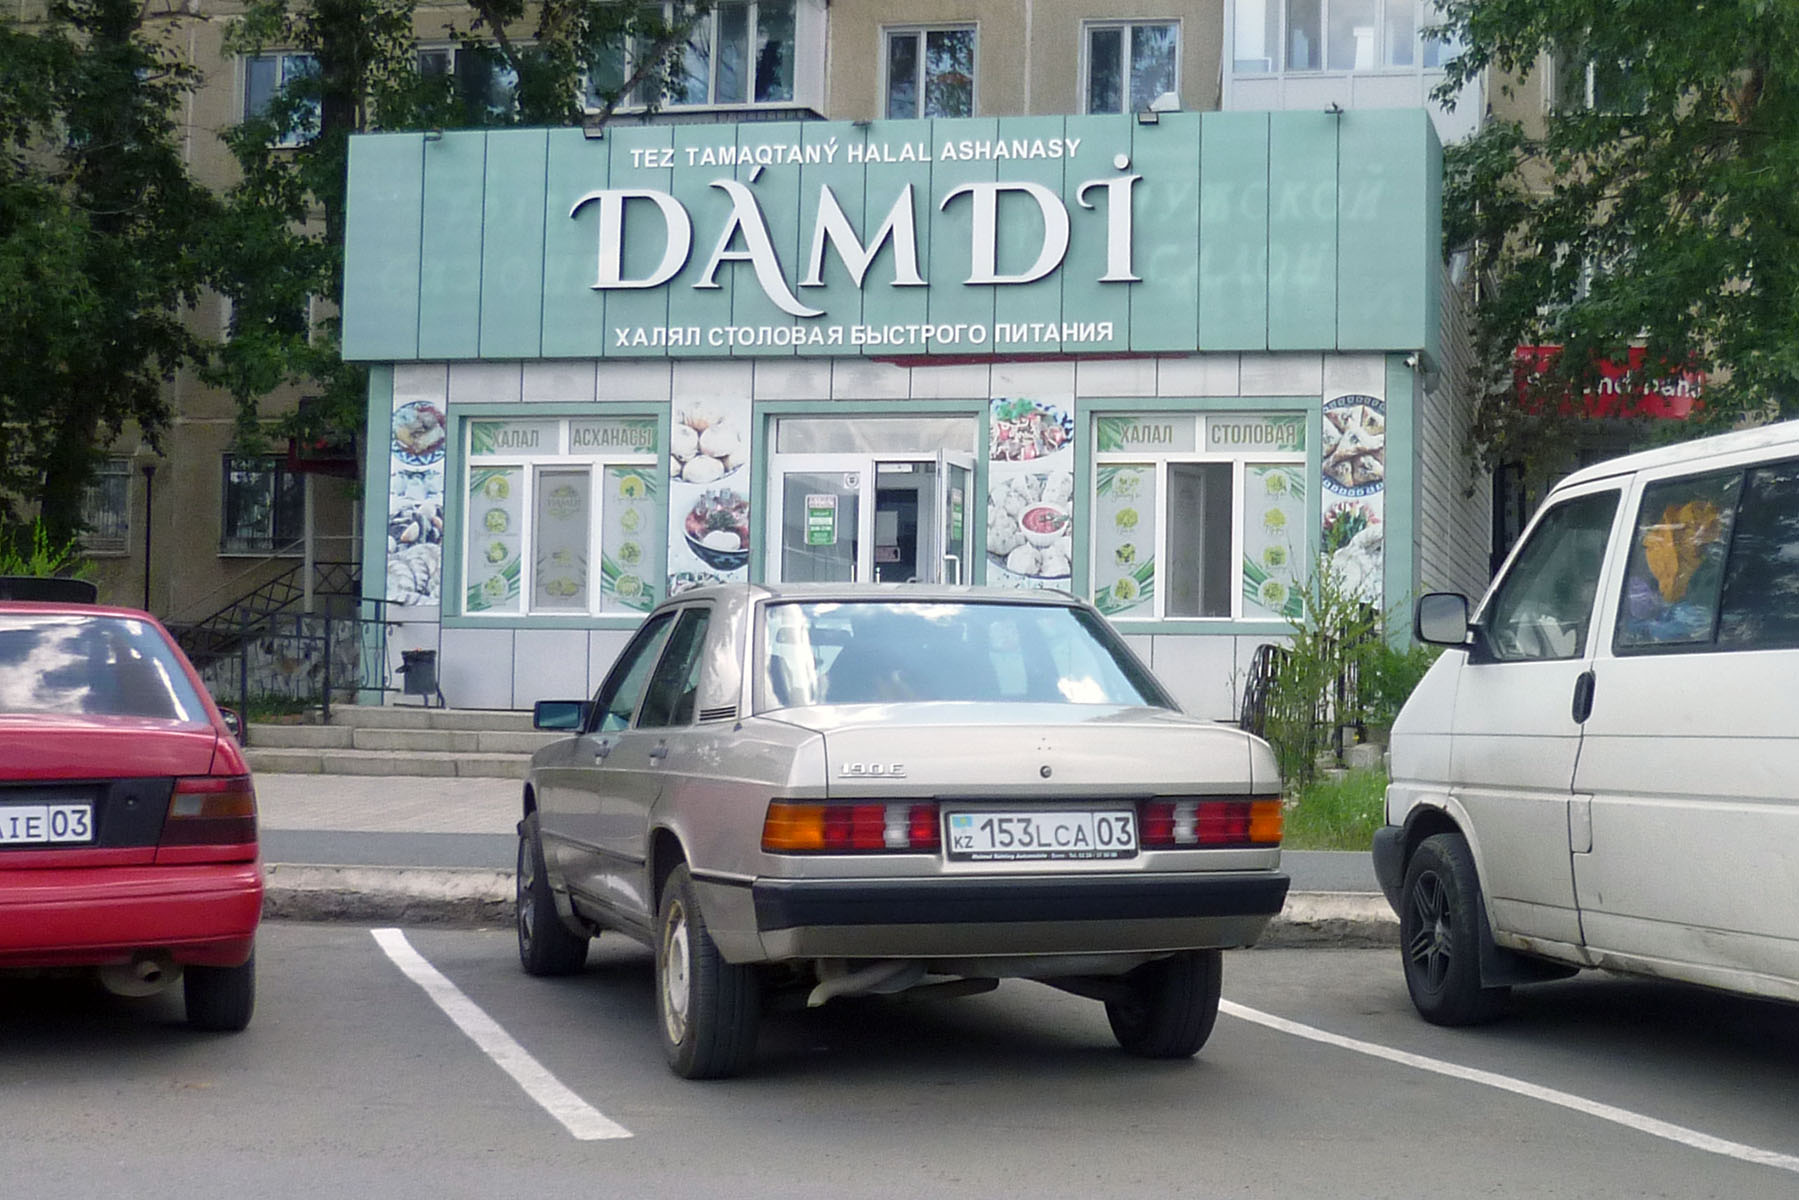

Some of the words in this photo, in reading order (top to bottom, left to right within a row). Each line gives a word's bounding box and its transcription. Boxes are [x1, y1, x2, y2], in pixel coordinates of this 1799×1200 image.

[630, 148, 675, 169] TEZ
[686, 137, 838, 167] TAMAQTANÝ
[848, 142, 932, 164] HALAL
[941, 138, 1082, 161] ASHANASY
[616, 326, 701, 348] ХАЛЯЛ
[708, 325, 843, 347] СТОЛОВАЯ
[851, 323, 986, 345] БЫСТРОГО
[996, 321, 1114, 343] ПИТАНИЯ
[492, 430, 540, 449] ХАЛАЛ
[573, 427, 653, 447] АСХАНАСЫ
[1120, 425, 1173, 443] ХАЛАЛ
[1211, 424, 1297, 444] СТОЛОВАЯ
[0, 816, 42, 839] IE
[52, 809, 89, 837] 03
[954, 835, 975, 849] KZ
[1096, 816, 1132, 845] 03
